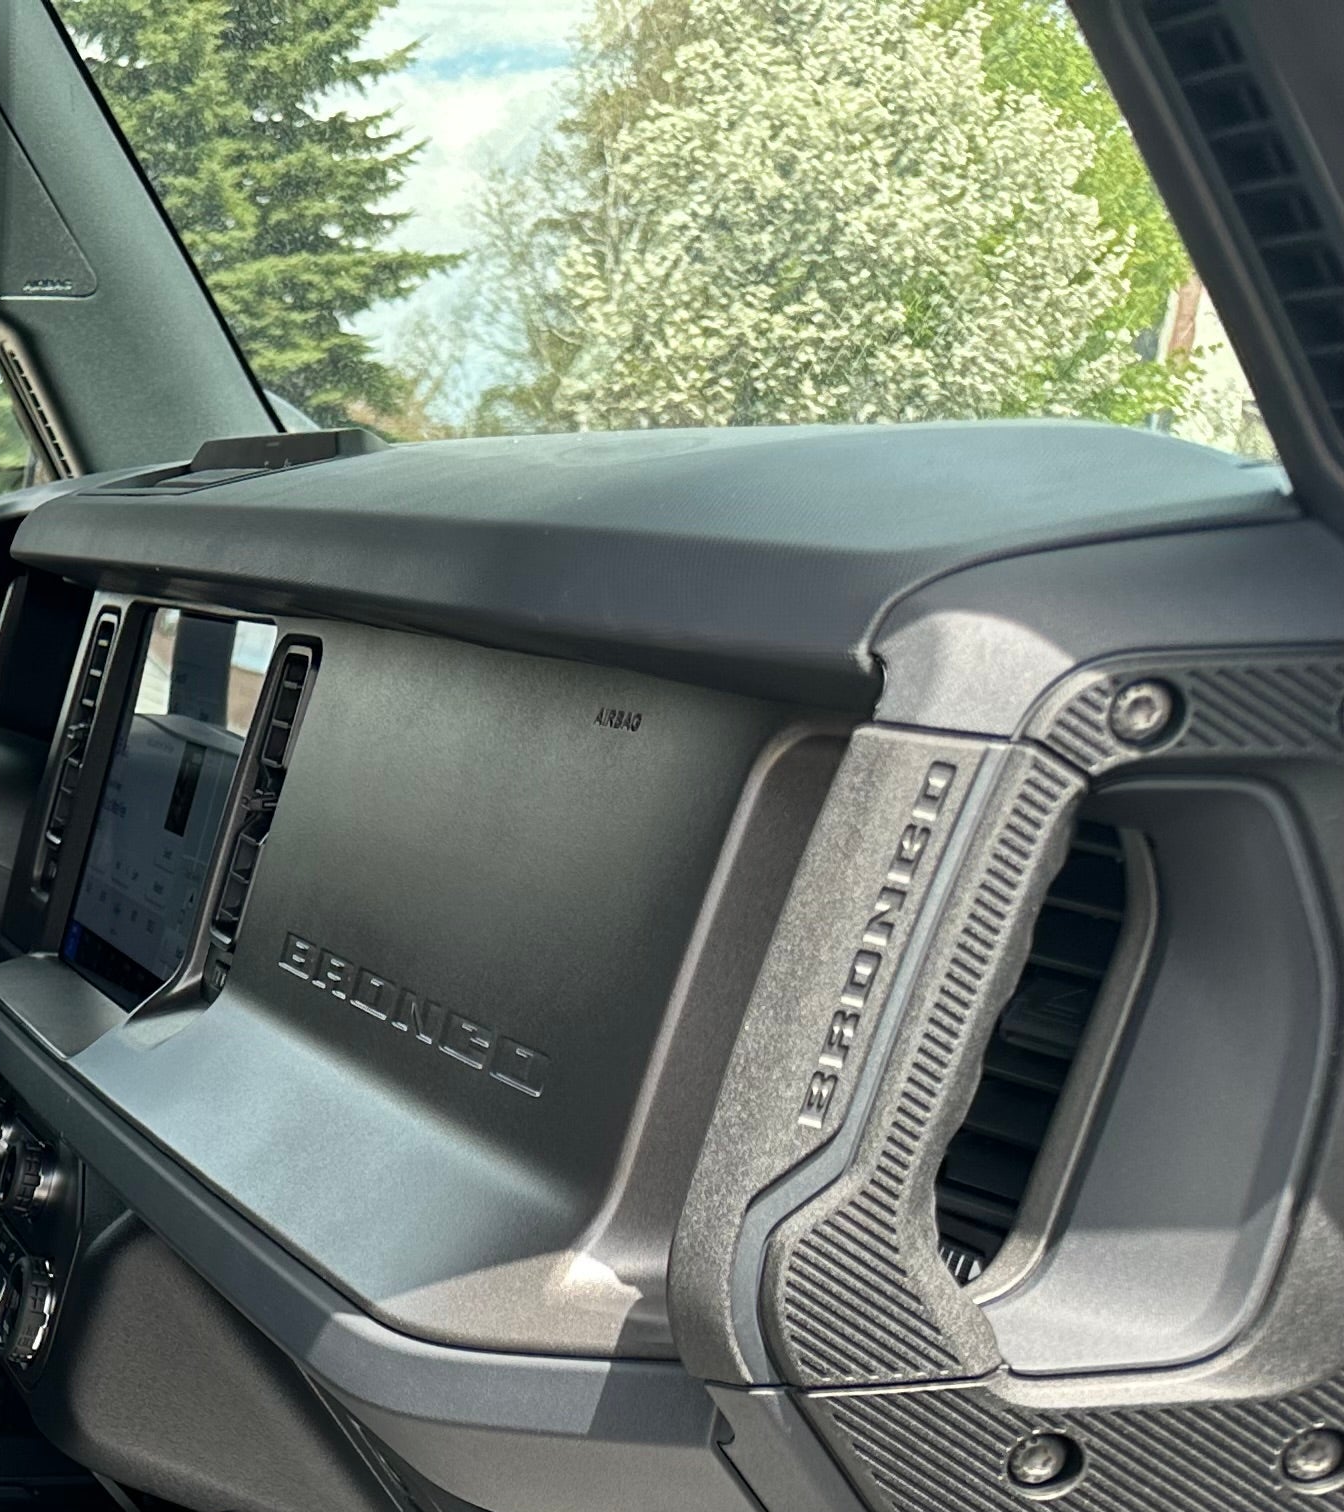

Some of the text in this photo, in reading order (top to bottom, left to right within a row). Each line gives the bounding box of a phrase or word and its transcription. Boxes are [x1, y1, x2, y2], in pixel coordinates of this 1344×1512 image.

[593, 707, 642, 732] AIRBAG
[278, 931, 551, 1098] BRONCO
[798, 760, 957, 1129] BRONCO
